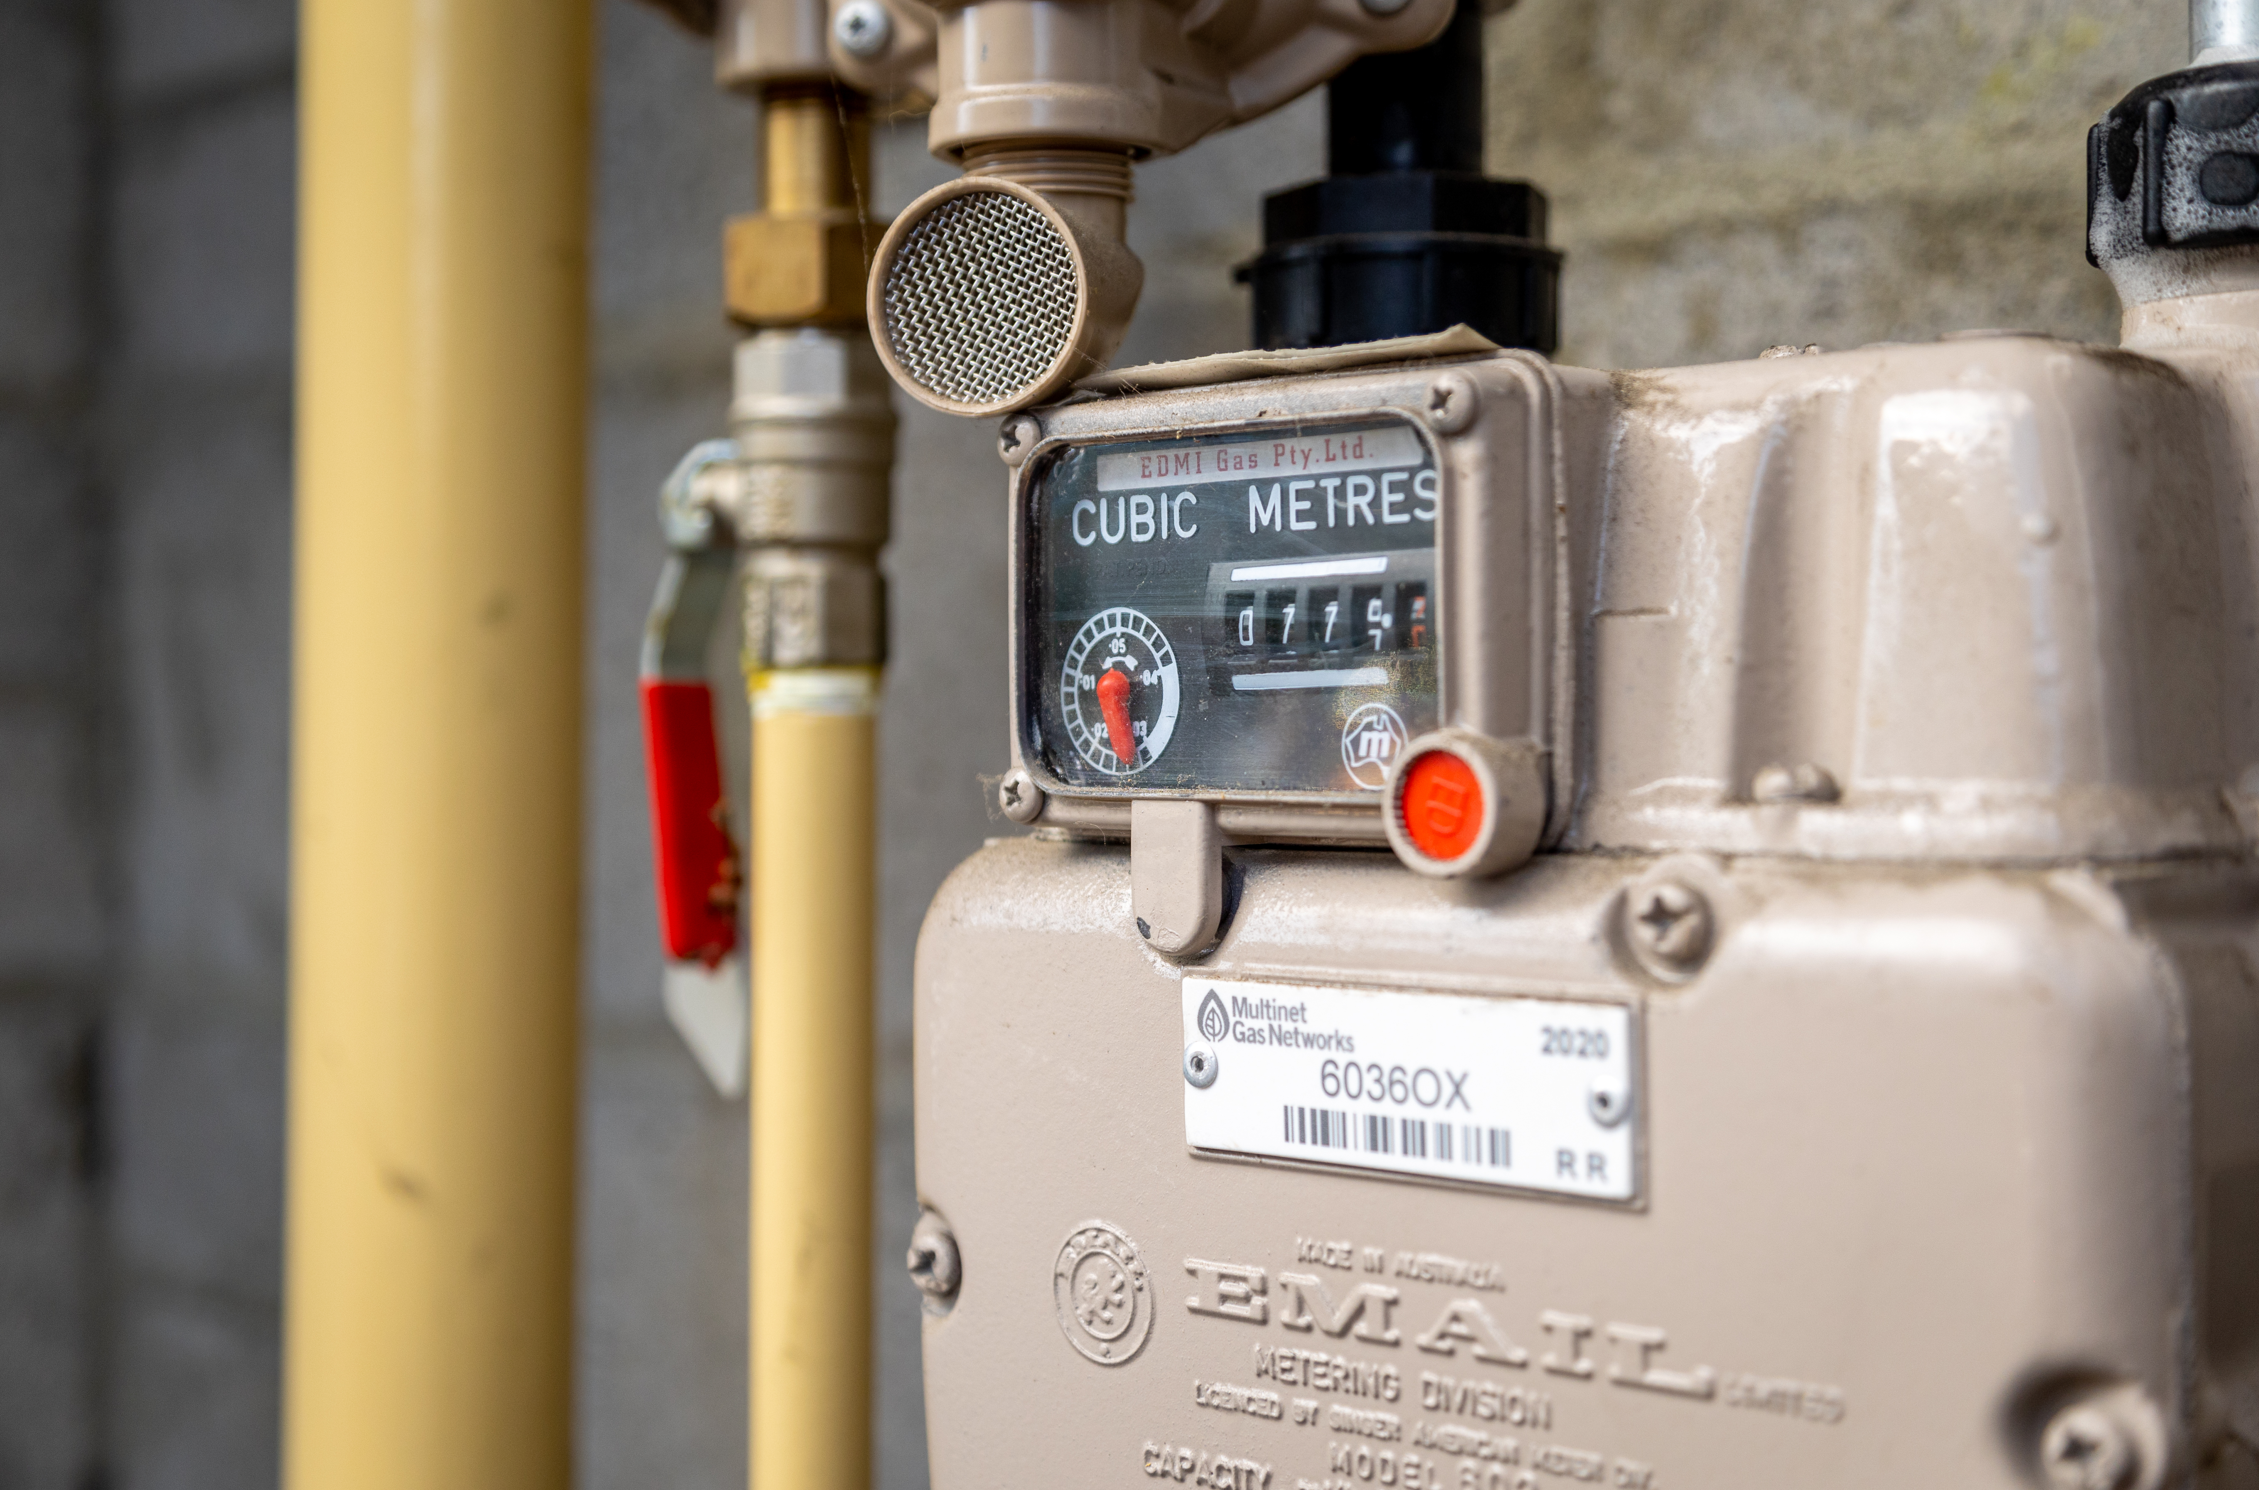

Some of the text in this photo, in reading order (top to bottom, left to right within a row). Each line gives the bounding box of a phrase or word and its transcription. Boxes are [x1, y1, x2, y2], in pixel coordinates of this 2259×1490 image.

[1140, 451, 1202, 479] EDMI
[1216, 449, 1259, 472] Gas
[1072, 469, 1437, 547] CUBIC METRES
[1231, 995, 1308, 1024] Multinet
[1232, 1021, 1356, 1053] Gas Networks
[1540, 1025, 1611, 1060] 2020
[1362, 1246, 1387, 1277] IN
[1395, 1252, 1508, 1296] AUSTRALIA
[1184, 1255, 1718, 1401] EMAIL
[1253, 1342, 1555, 1431] METERING DIVISION
[1141, 1440, 1274, 1490] CAPACITY
[1328, 1440, 1443, 1490] MODEL
